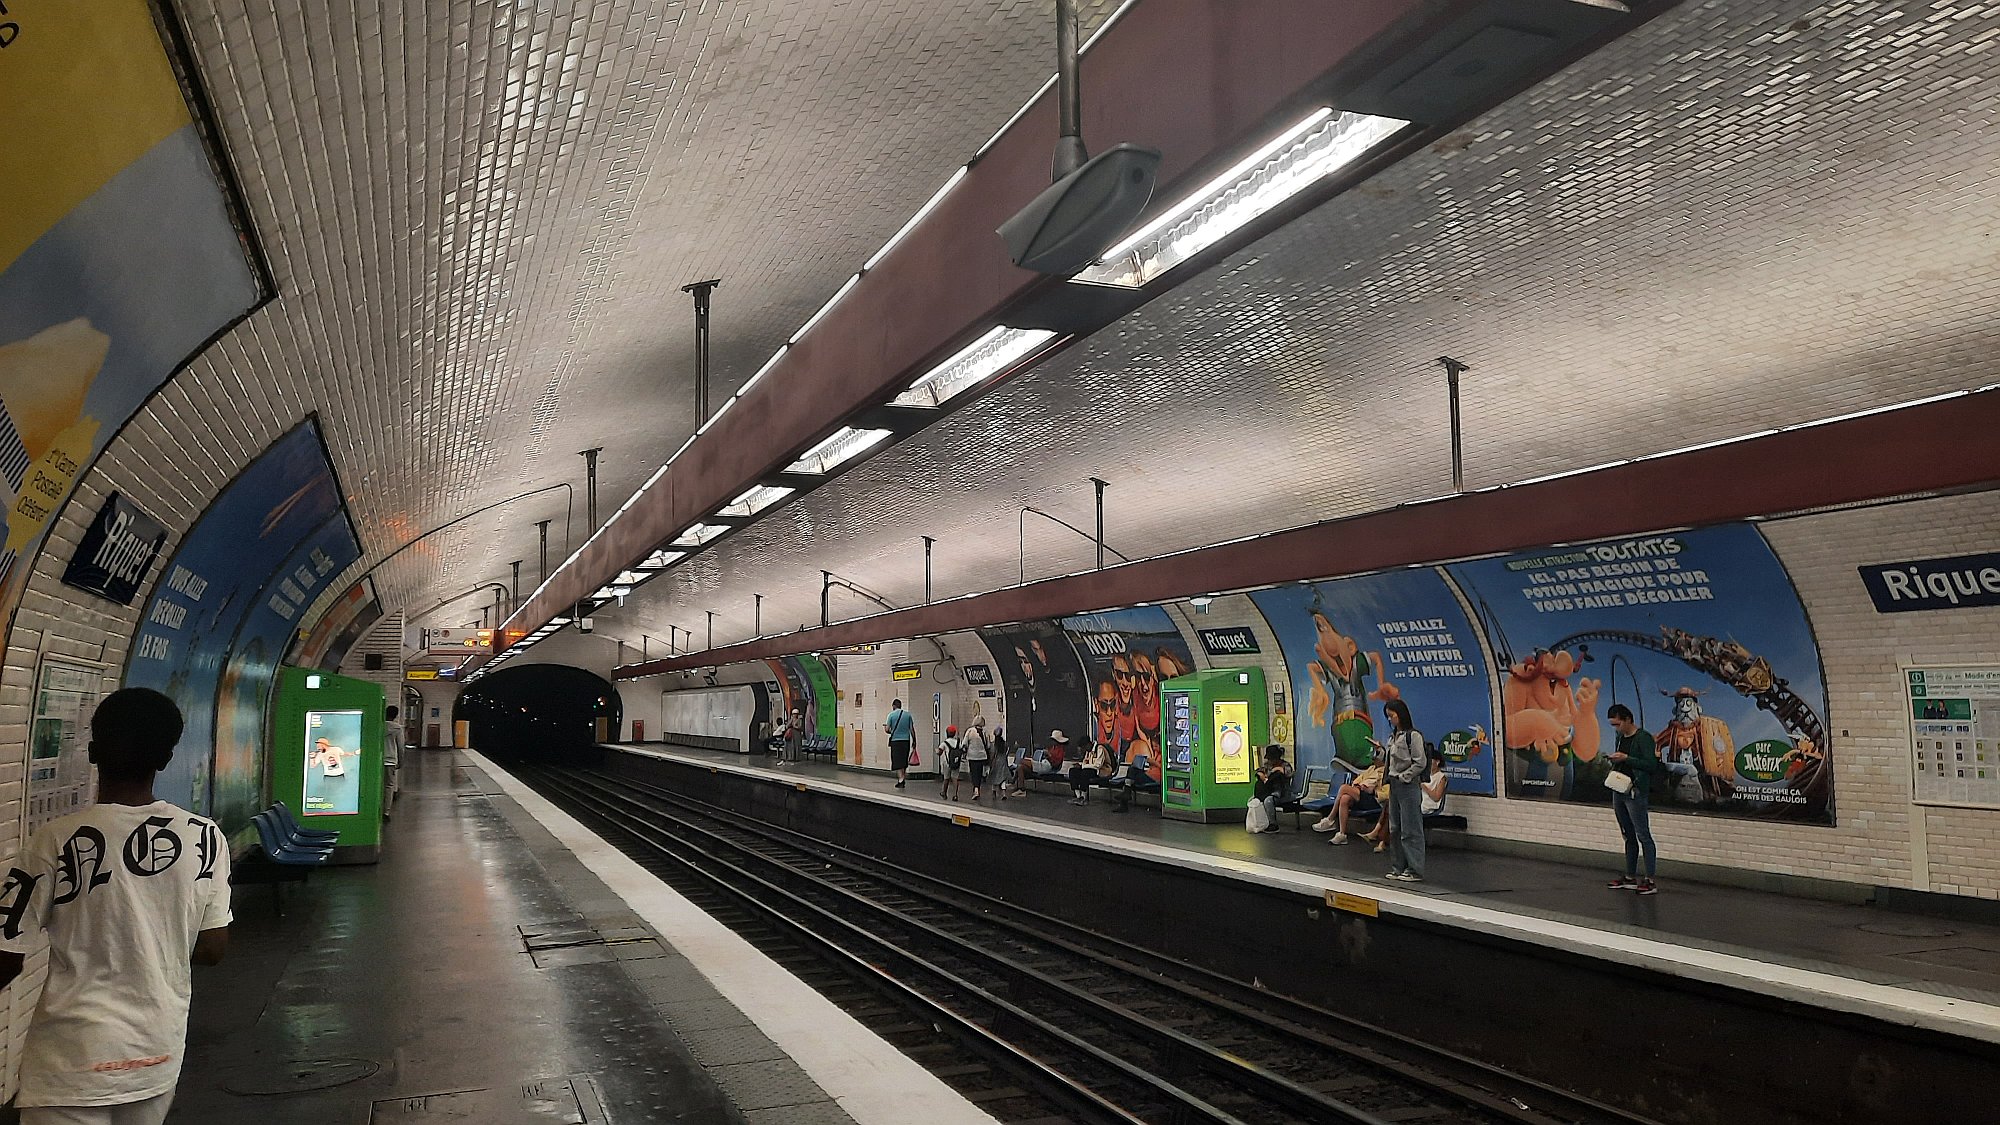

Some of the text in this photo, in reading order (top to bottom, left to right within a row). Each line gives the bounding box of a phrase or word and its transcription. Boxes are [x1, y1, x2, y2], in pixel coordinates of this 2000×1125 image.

[92, 511, 157, 588] Riquet
[1528, 558, 1681, 585] ICI, PAS BESOIN DE
[1522, 570, 1711, 600] POTION MAGIQUE POUR
[1532, 586, 1715, 613] VOUS FAIRE DÉCOLLER
[1377, 618, 1446, 634] VOUS ALLEZ
[1082, 633, 1126, 655] NORD
[1205, 631, 1250, 652] Riquet
[1384, 633, 1455, 648] PRENDRE DE
[1389, 649, 1463, 664] LA HAUTEUR
[967, 668, 988, 682] Riquet
[1407, 666, 1420, 677] 51
[1755, 743, 1772, 753] parc
[1744, 753, 1782, 772] Astérix
[1743, 793, 1760, 801] PAYS
[1761, 794, 1774, 802] DES
[1775, 795, 1807, 804] GAULOIS
[1748, 786, 1761, 794] EST
[1762, 787, 1789, 796] COMME
[1790, 788, 1801, 797] ÇA
